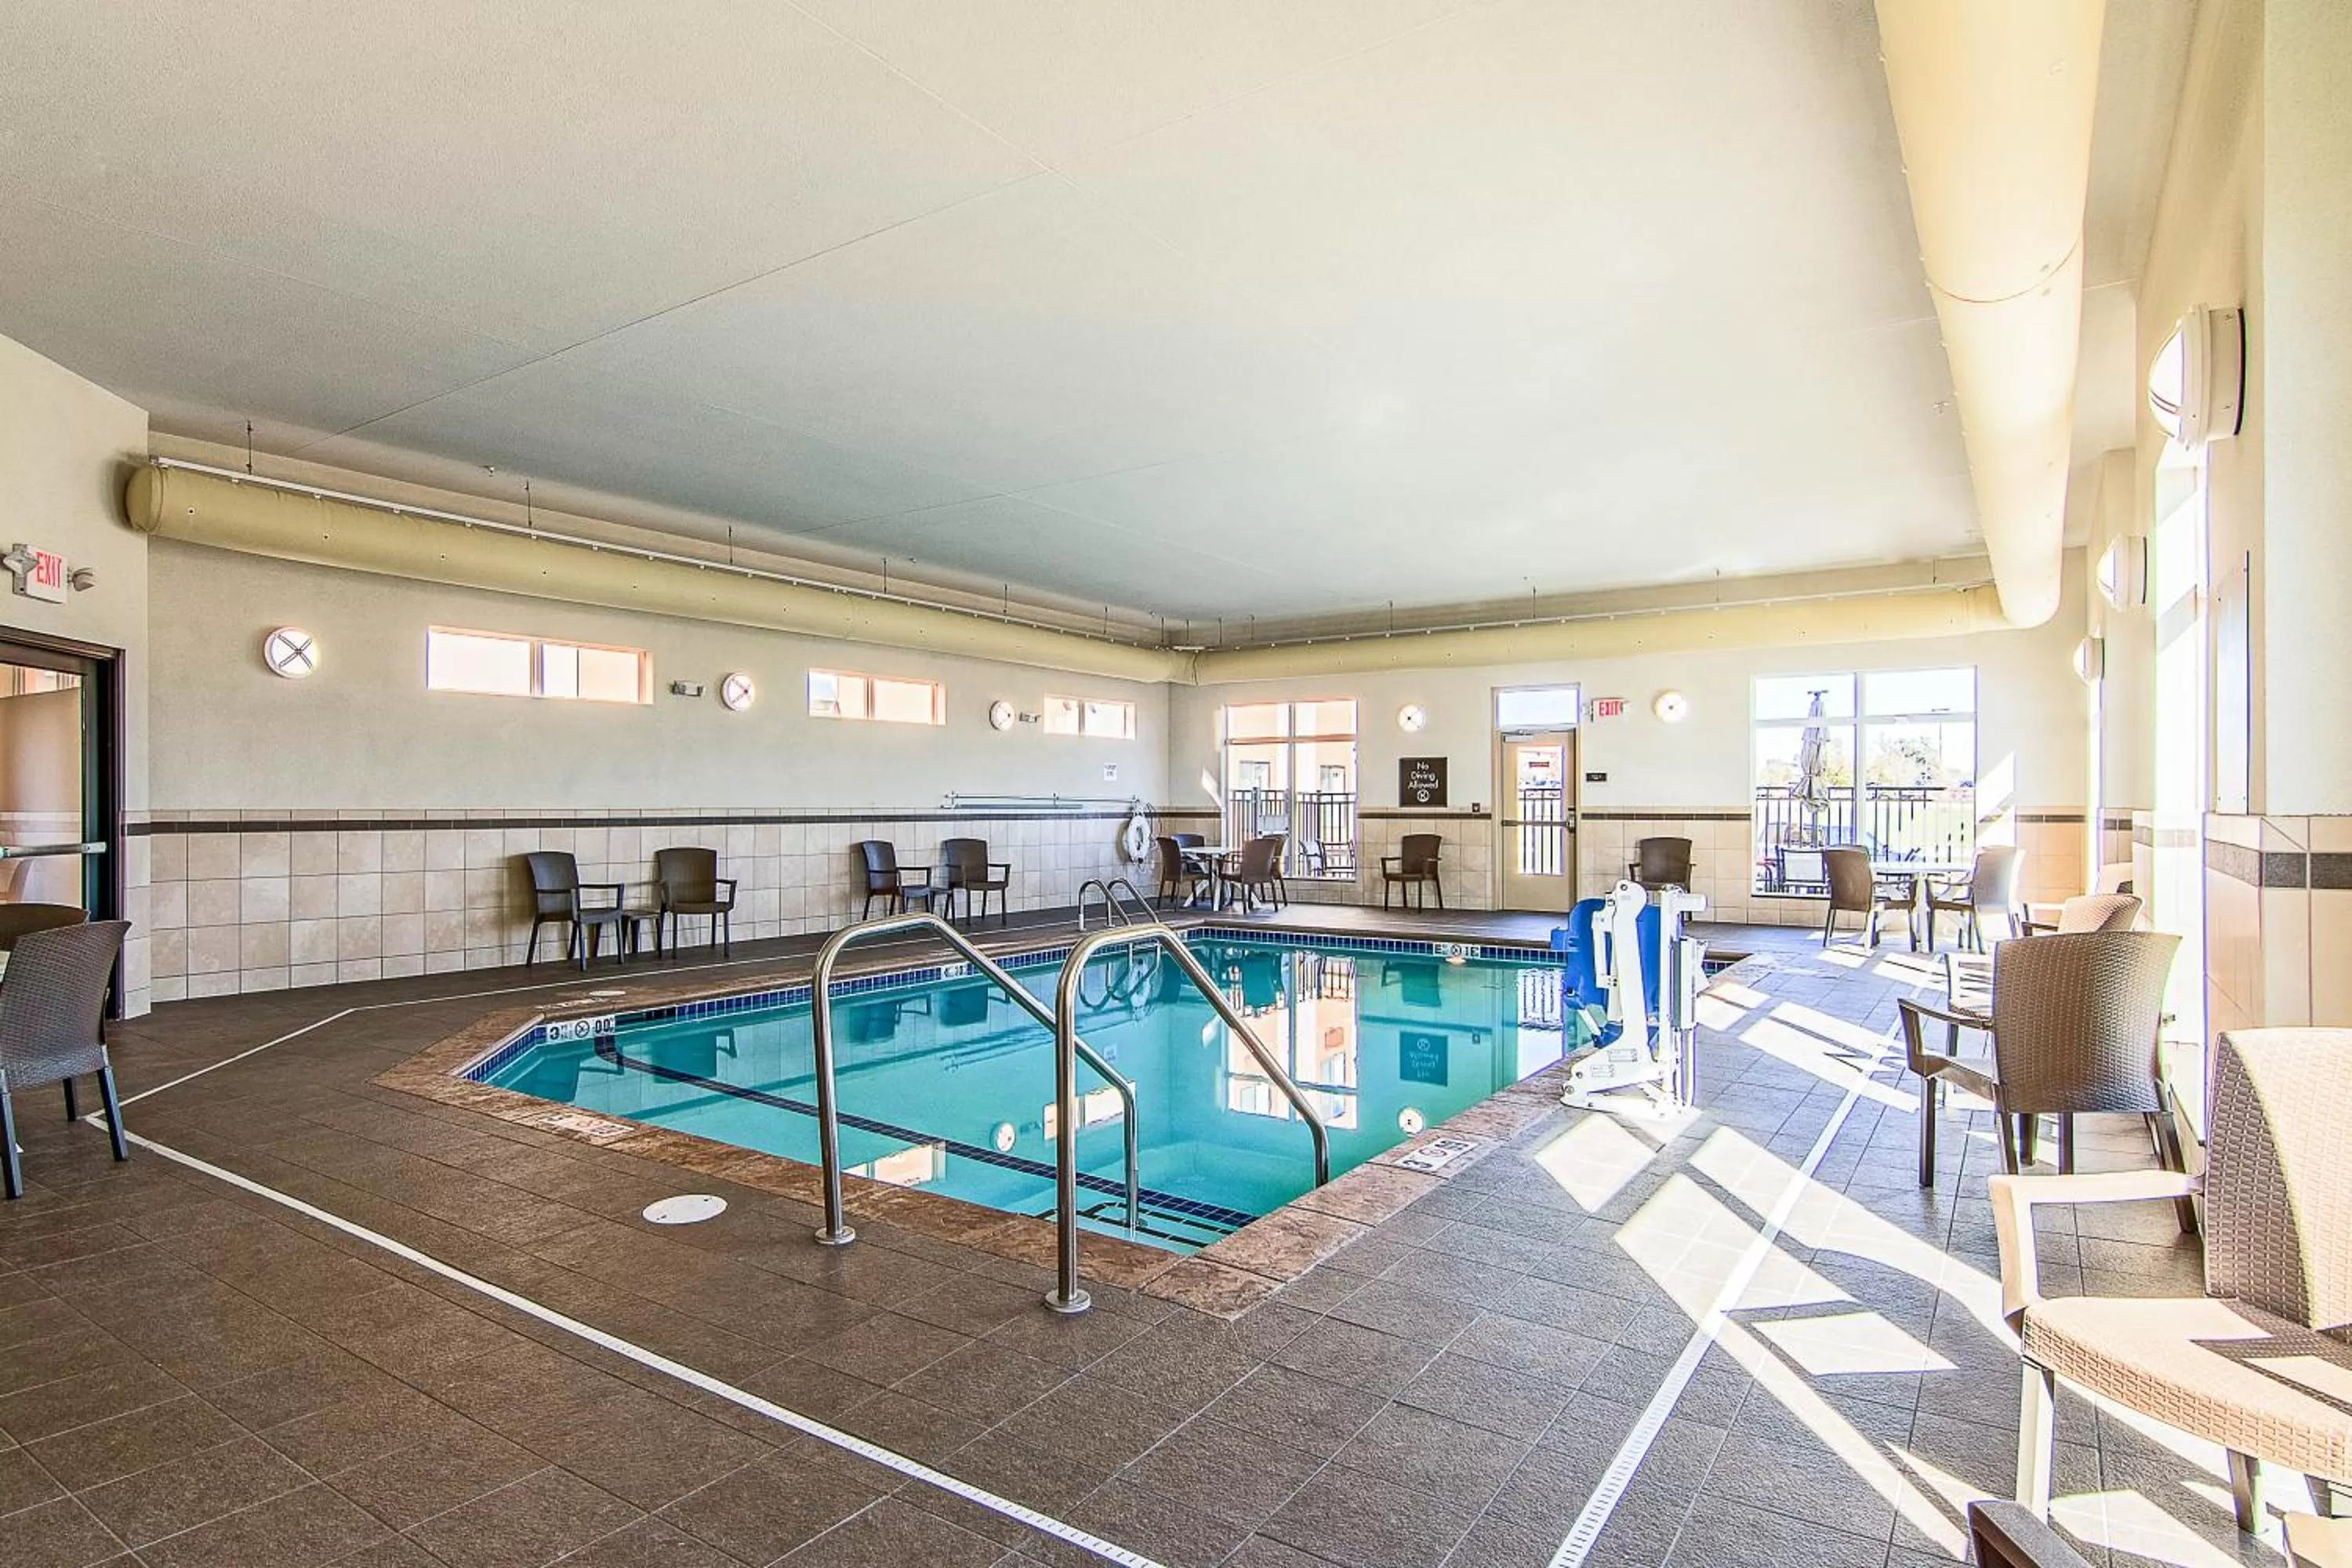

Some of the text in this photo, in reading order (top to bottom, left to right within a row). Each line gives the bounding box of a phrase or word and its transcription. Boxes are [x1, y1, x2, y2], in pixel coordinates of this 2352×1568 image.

[36, 551, 62, 589] EXIT
[1599, 701, 1619, 717] EXIT
[1410, 771, 1436, 782] Diving
[1407, 779, 1439, 789] Allowed
